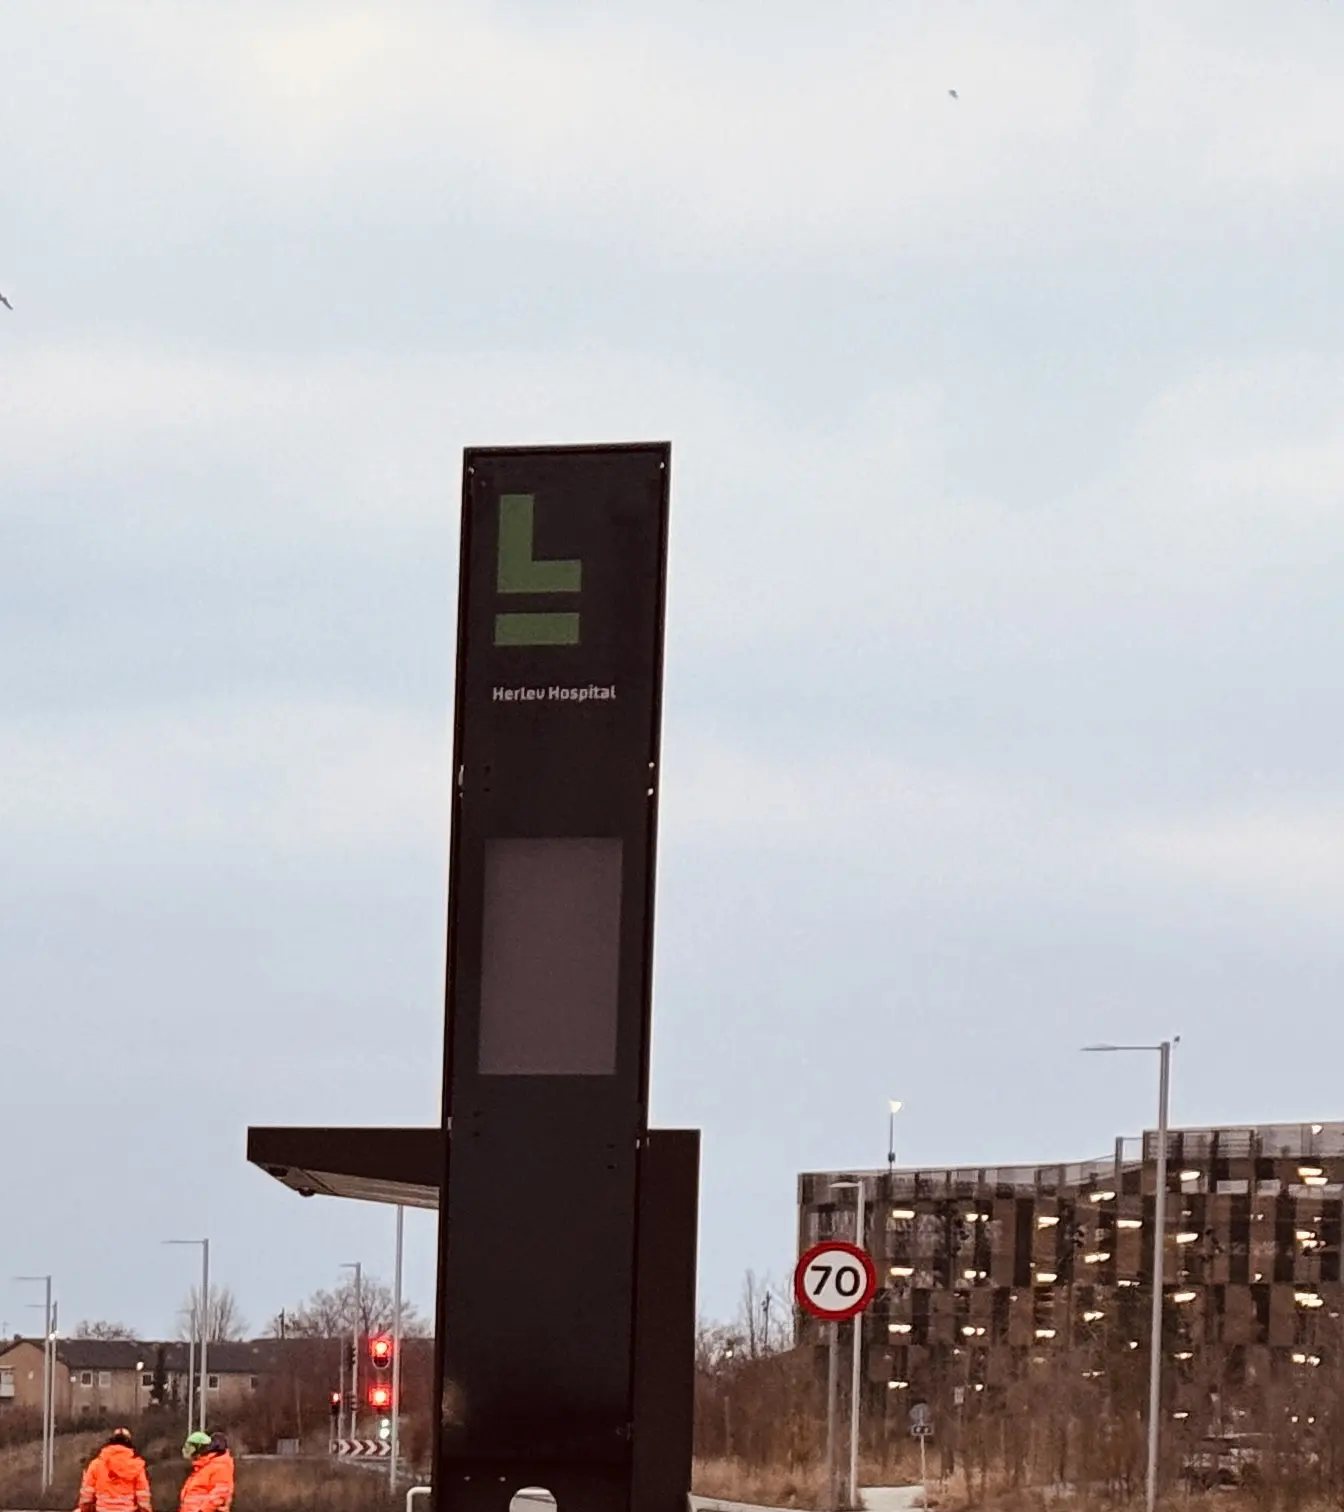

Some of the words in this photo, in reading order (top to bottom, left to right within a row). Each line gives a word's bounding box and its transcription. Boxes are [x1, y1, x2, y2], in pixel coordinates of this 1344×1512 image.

[492, 686, 546, 701] Herlev
[548, 684, 617, 702] Hospital
[811, 1265, 860, 1297] 70
